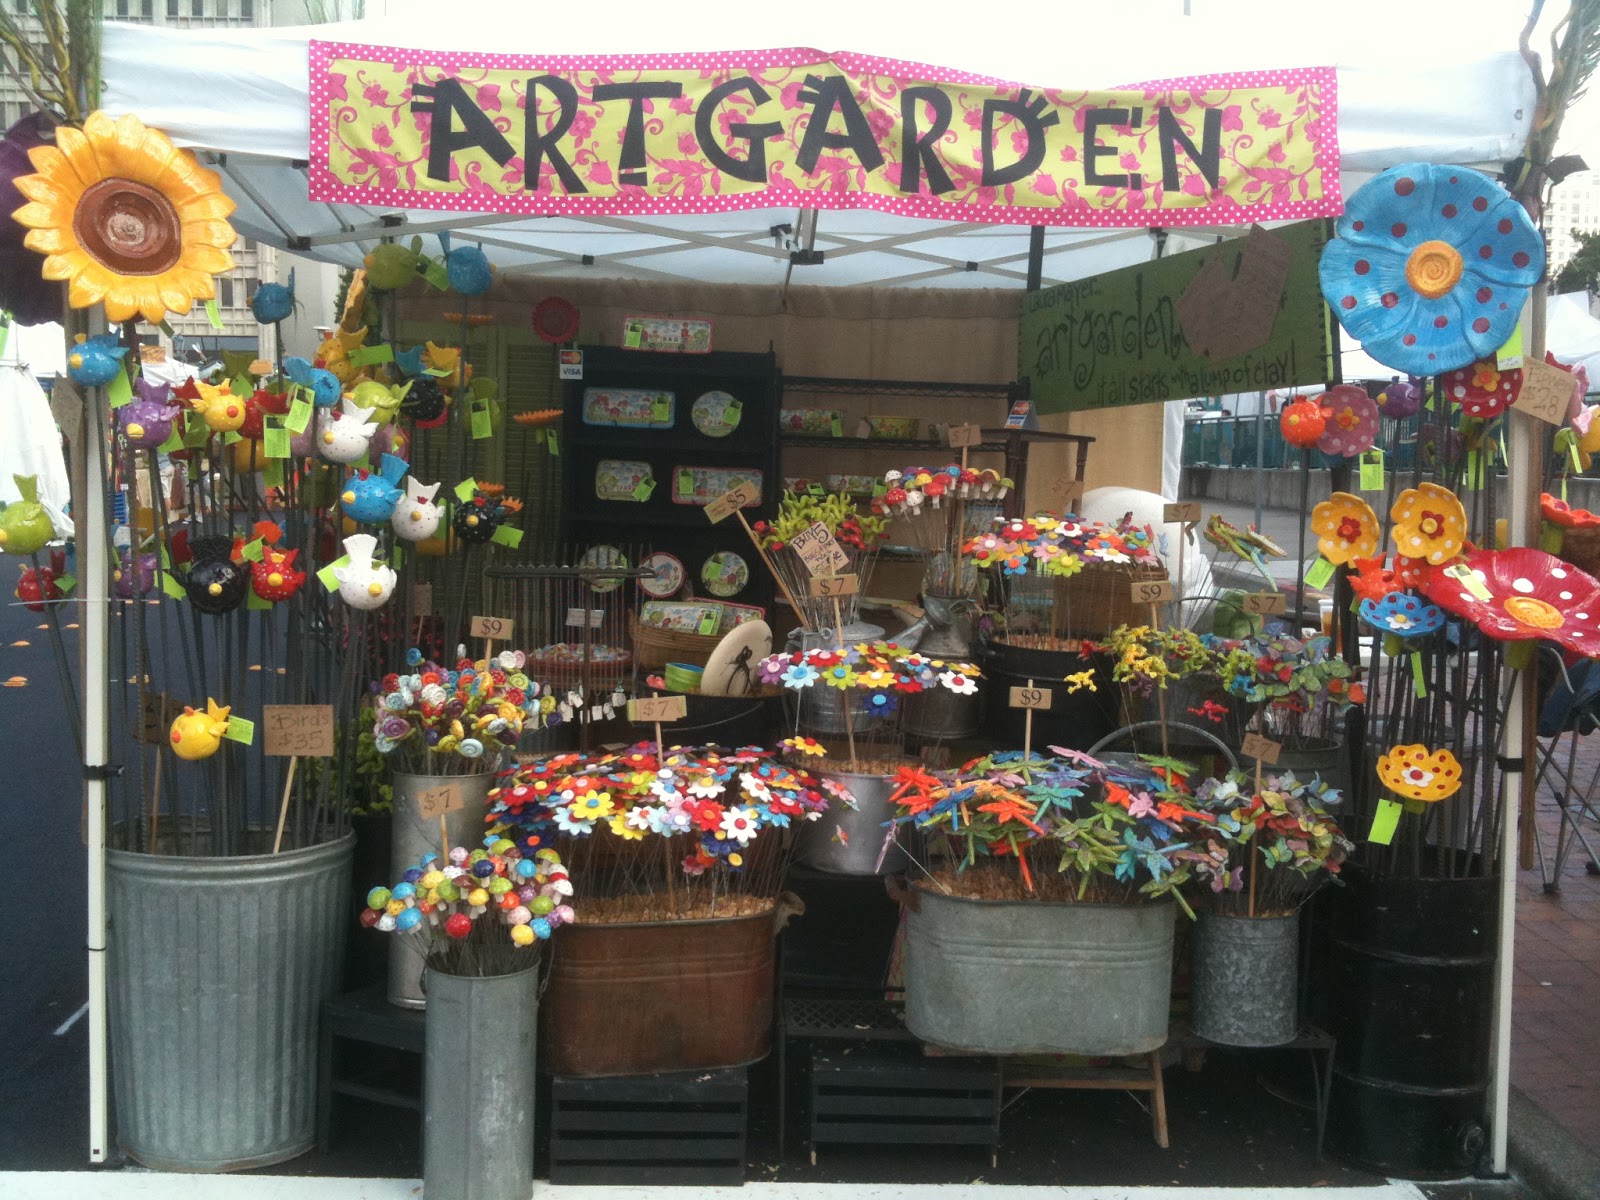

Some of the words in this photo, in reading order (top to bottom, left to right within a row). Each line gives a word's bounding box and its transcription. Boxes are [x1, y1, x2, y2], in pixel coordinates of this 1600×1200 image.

[563, 368, 581, 376] VISA
[1233, 355, 1253, 388] of
[726, 488, 746, 509] $5
[815, 523, 829, 544] 5
[820, 578, 845, 595] $7
[1140, 584, 1162, 601] $9
[1249, 596, 1278, 612] $7
[481, 618, 502, 636] $9
[1020, 689, 1041, 706] $9
[643, 700, 669, 717] $7
[271, 710, 330, 731] Birds
[278, 730, 324, 750] $35
[423, 788, 451, 812] $7
